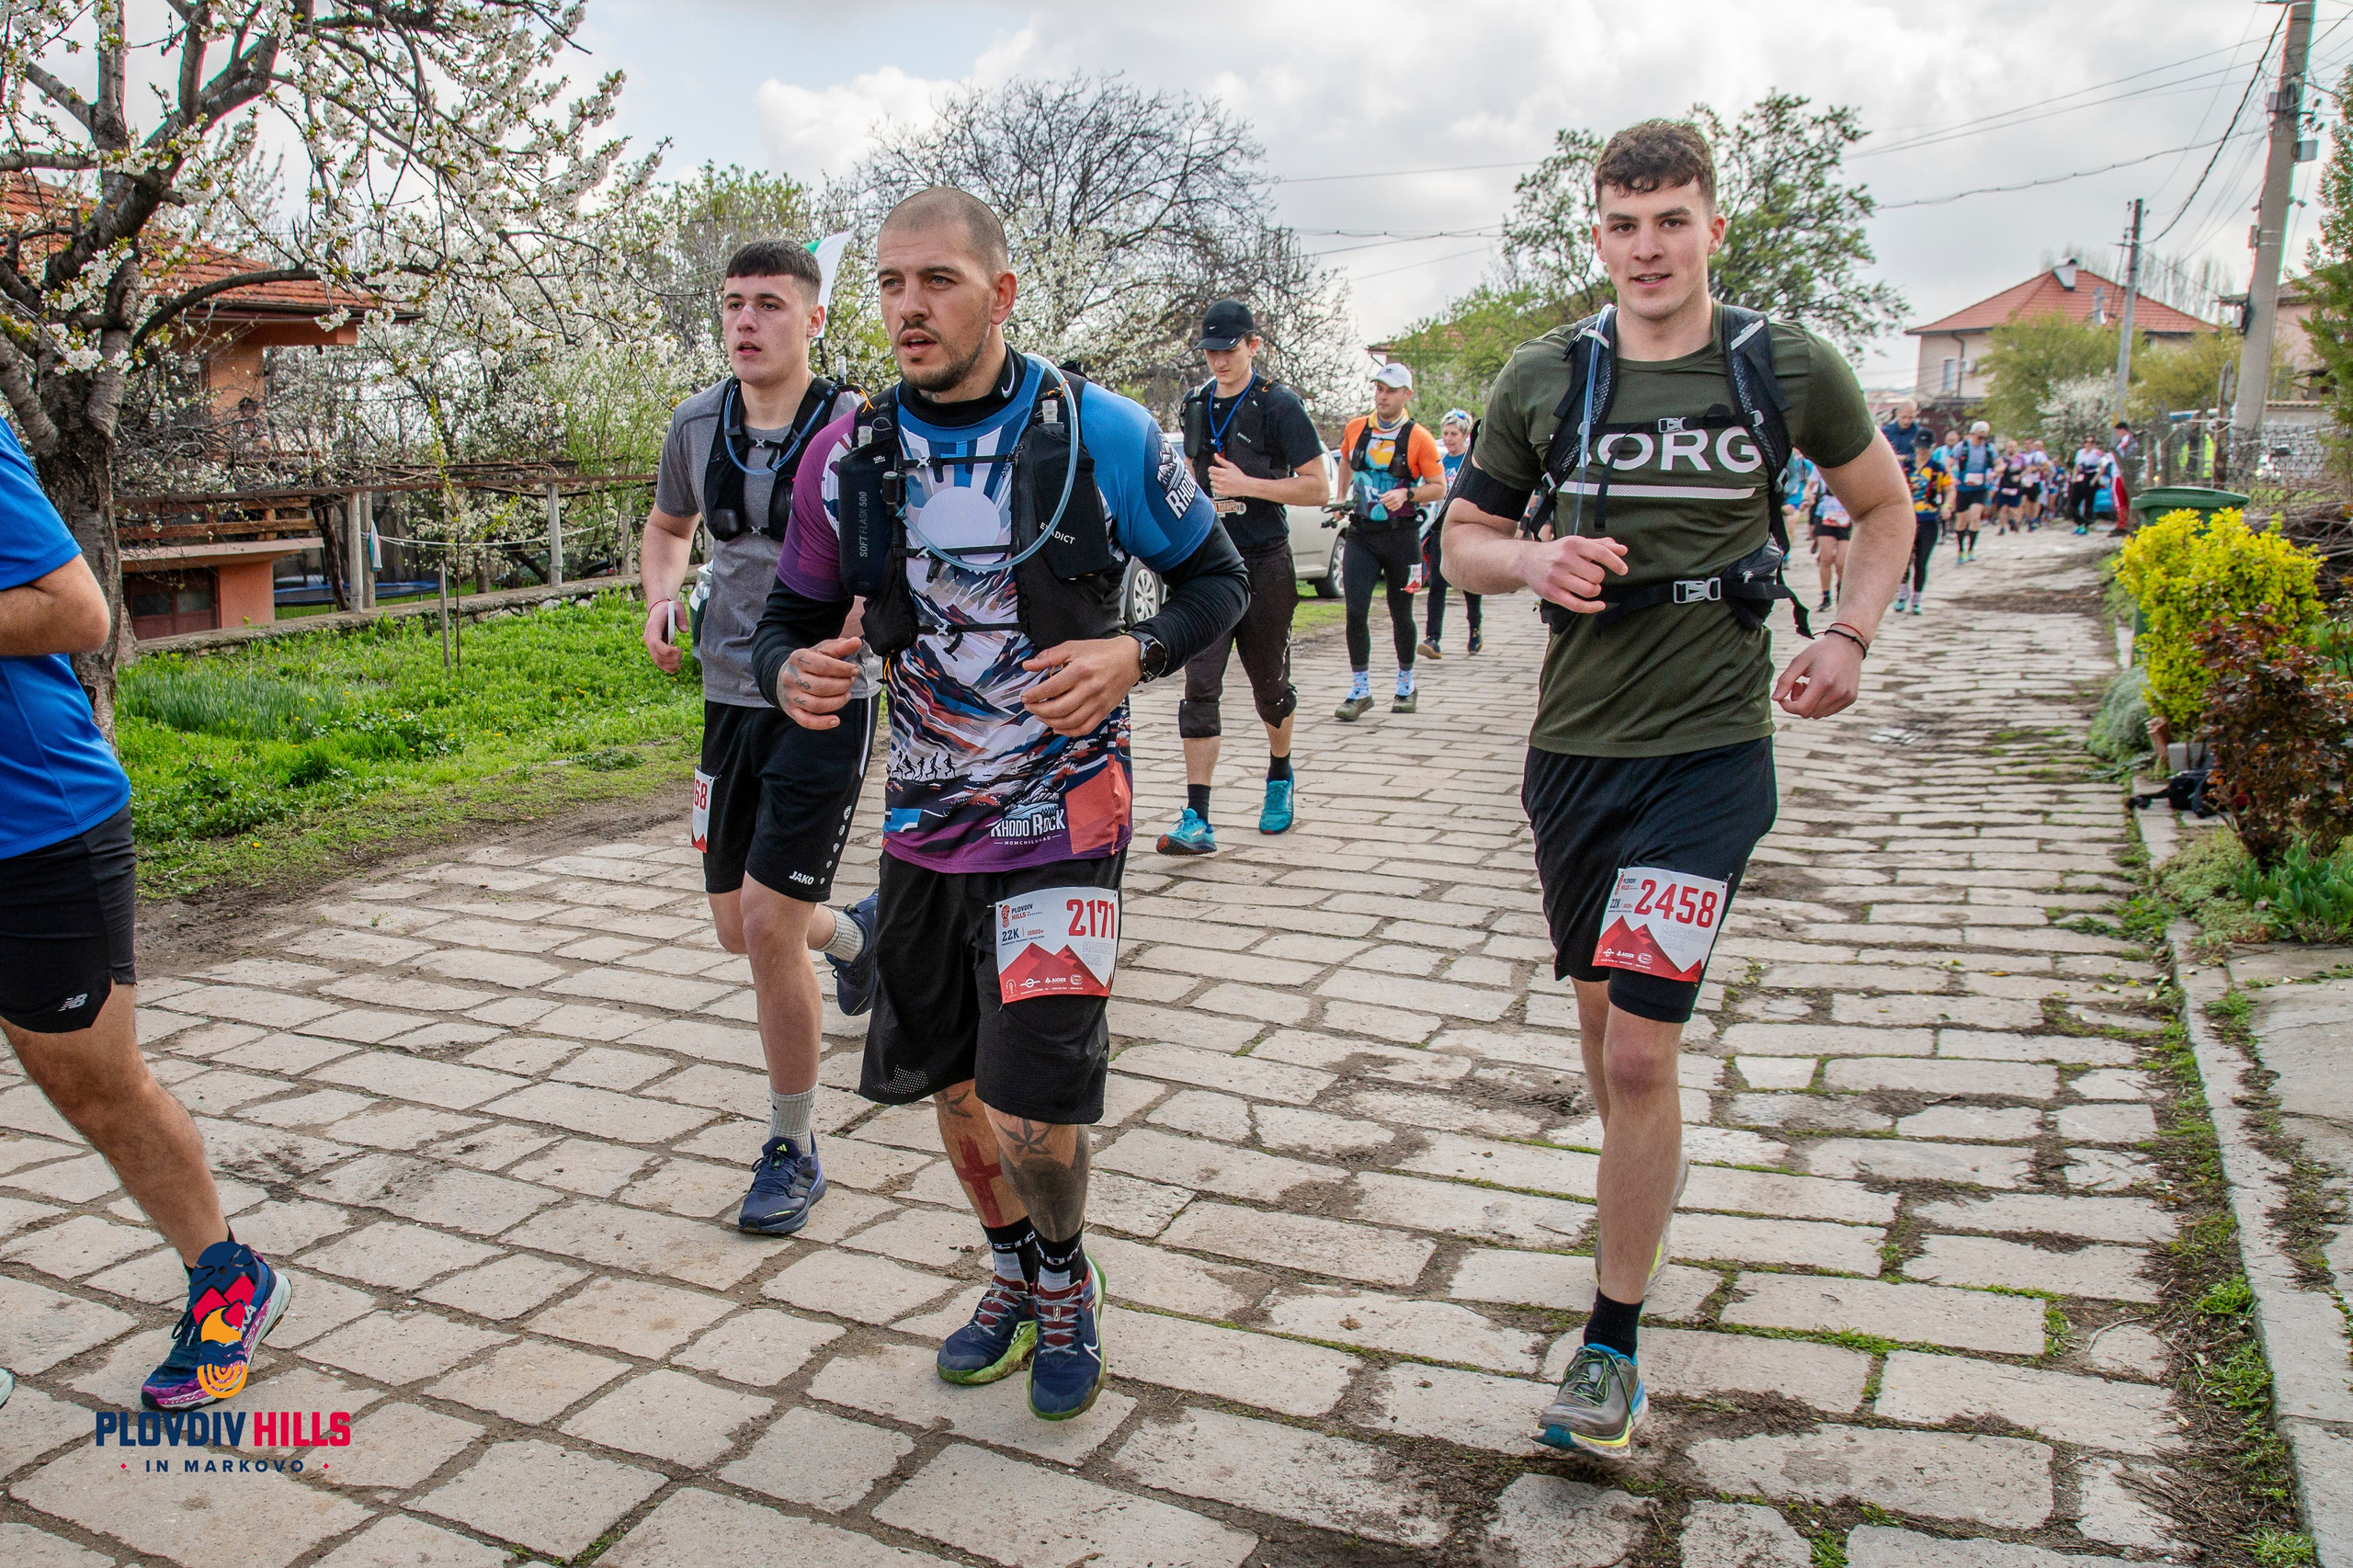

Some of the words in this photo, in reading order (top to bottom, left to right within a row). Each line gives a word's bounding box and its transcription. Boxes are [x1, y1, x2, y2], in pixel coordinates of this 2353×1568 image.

[1551, 426, 1763, 473] ORG
[859, 491, 868, 506] 500
[859, 508, 868, 534] FLASK
[1040, 522, 1075, 544] EDICT
[859, 536, 869, 558] SOFT
[1032, 809, 1066, 836] ROCK
[789, 870, 814, 885] JAKO
[1011, 903, 1034, 915] PLOVDIV
[1634, 879, 1718, 928] 2458
[1011, 911, 1027, 921] HILLS
[1066, 898, 1115, 939] 2171
[1002, 927, 1020, 942] 22K
[1658, 936, 1686, 952] TRAIL
